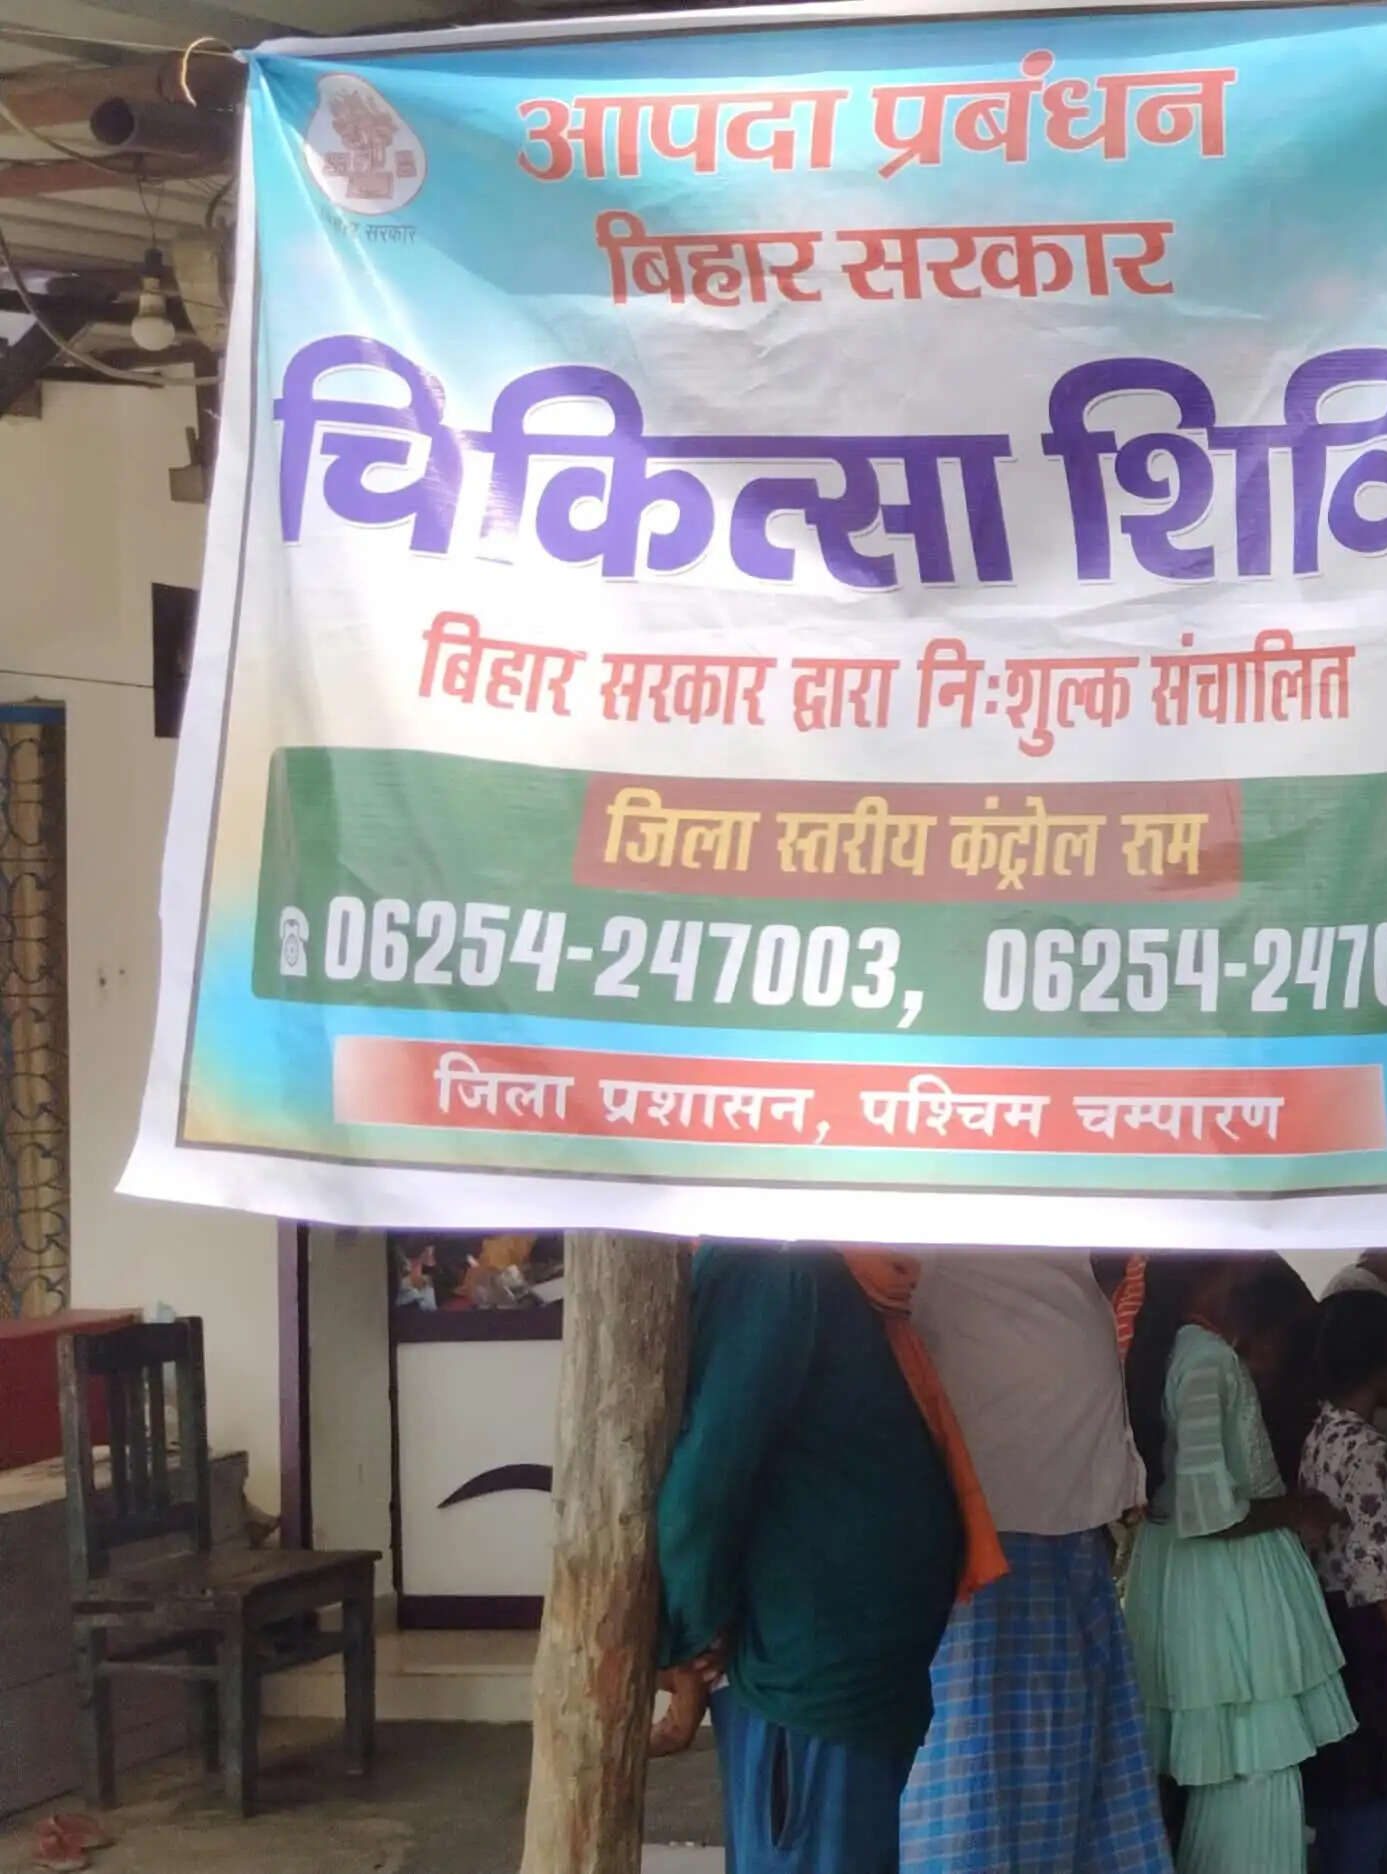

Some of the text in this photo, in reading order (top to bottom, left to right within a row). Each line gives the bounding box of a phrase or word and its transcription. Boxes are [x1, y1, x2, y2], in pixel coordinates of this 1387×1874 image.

[518, 50, 1236, 181] आपदा प्रबंधन
[596, 211, 1173, 308] बिहार सरकार
[274, 334, 1011, 590] चिकित्सा
[418, 611, 585, 717] बिहार
[601, 654, 776, 725] सरकार
[793, 659, 900, 731] द्वारा
[1151, 629, 1355, 728] संचालित
[605, 787, 760, 872] जिला
[776, 797, 937, 876] स्तरीय
[951, 797, 1105, 889] कंट्रोल
[324, 895, 923, 1028] 06254-247003,
[434, 1052, 1284, 1144] जिला प्रशासन, पश्चिम चम्पारण
